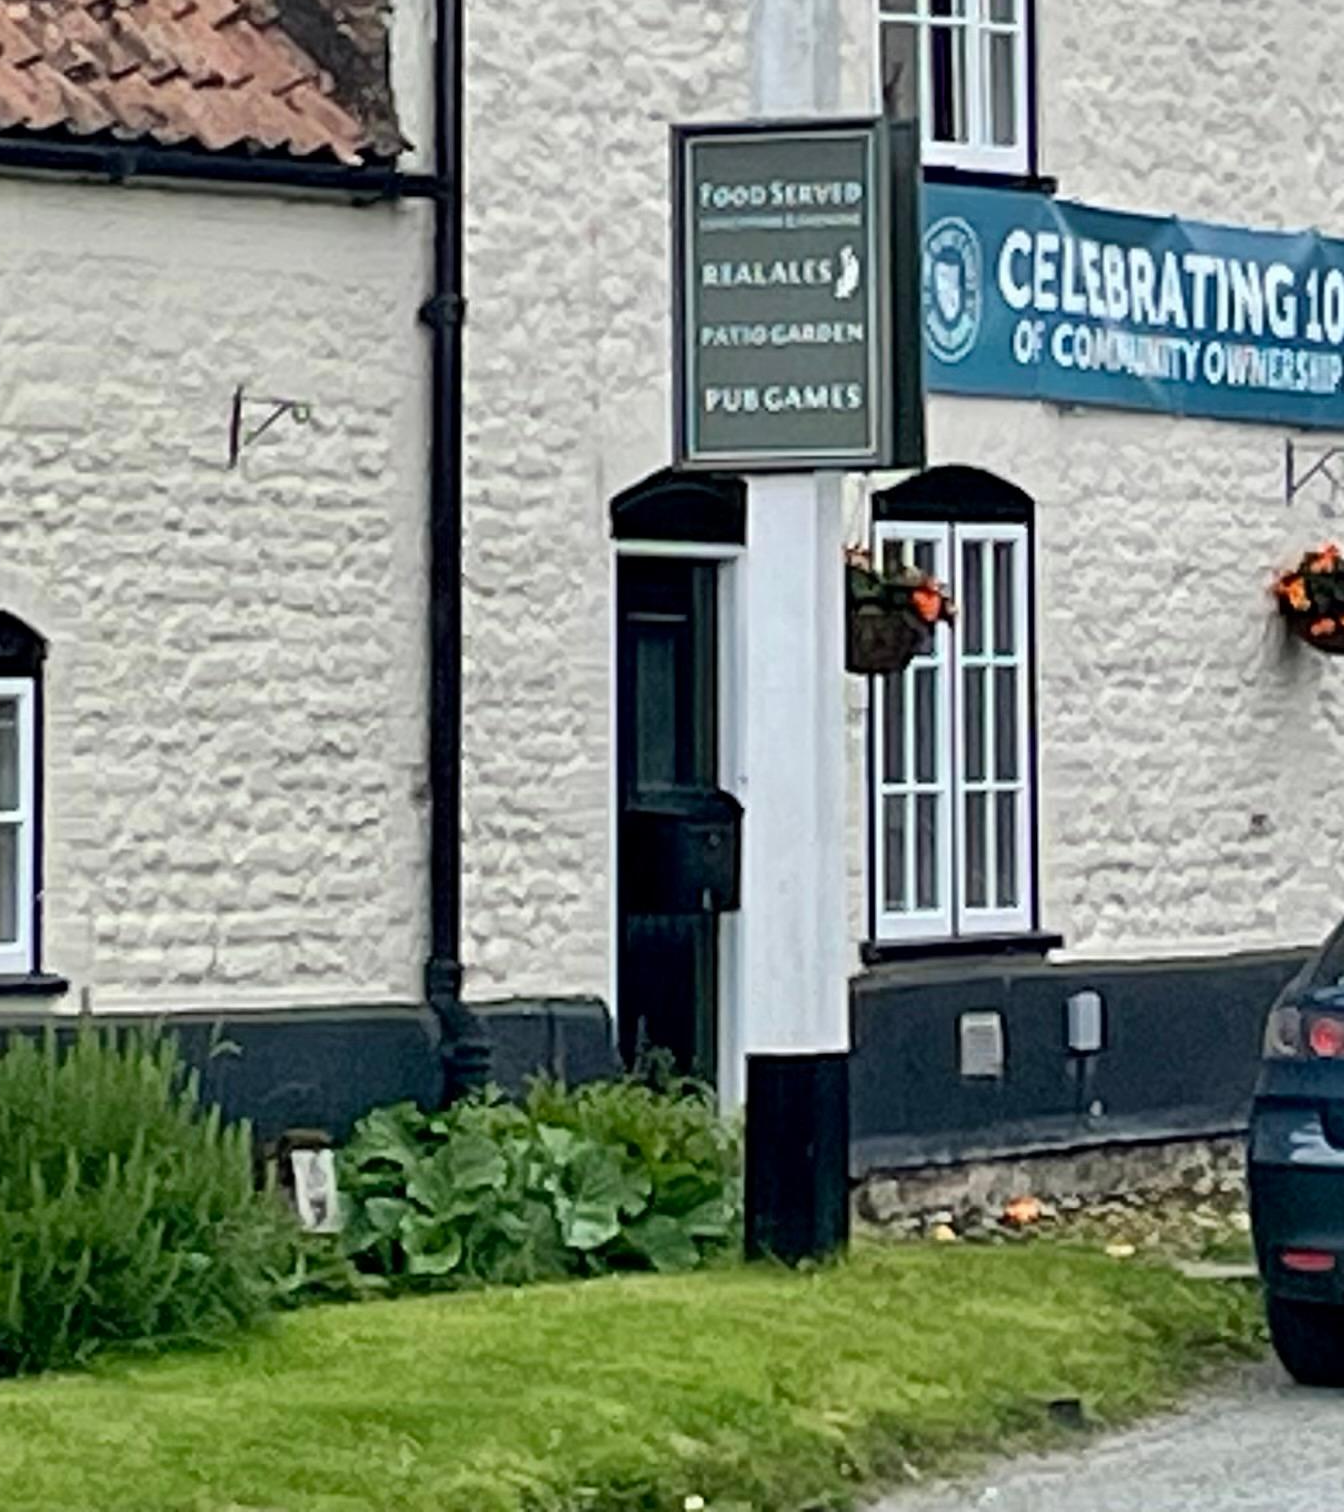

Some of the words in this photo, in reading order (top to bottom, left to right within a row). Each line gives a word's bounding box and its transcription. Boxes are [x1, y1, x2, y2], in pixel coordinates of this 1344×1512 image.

[699, 183, 767, 208] FOOD
[769, 180, 863, 206] SERVED
[702, 261, 768, 286] REAL
[769, 259, 833, 285] ALES
[998, 229, 1297, 338] CELEBRATING
[701, 325, 767, 349] PATIO
[770, 322, 864, 345] GARDEN
[1013, 319, 1046, 364] OF
[1052, 323, 1200, 381] COMMUNITY
[1203, 343, 1343, 394] OWNERSHIP
[705, 388, 760, 413] PUB
[763, 384, 863, 410] GAMES
